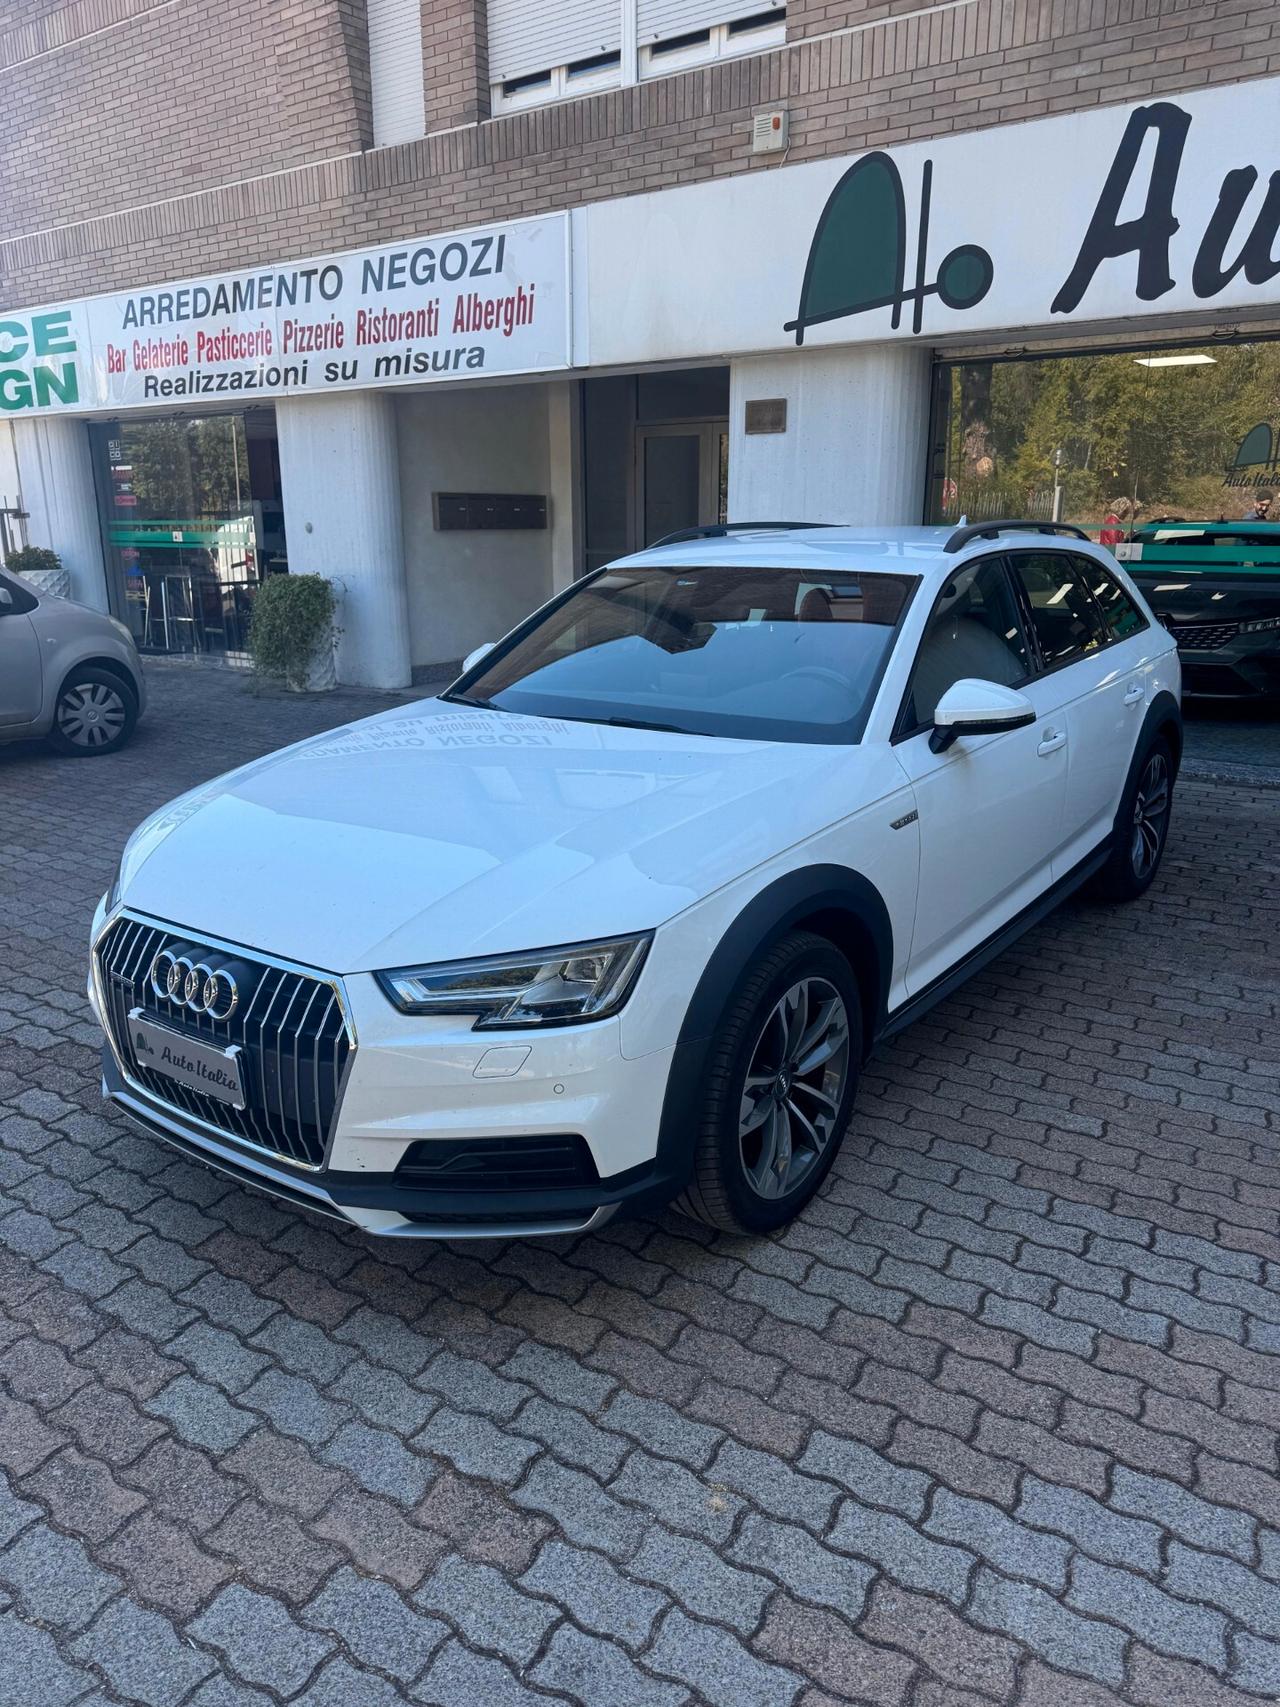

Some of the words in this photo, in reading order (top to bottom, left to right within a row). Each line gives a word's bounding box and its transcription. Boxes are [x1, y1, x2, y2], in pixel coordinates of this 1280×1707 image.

[122, 264, 343, 330] ARREDAMENTO
[361, 234, 506, 295] NEGOZI
[107, 343, 126, 374] Bar
[132, 334, 188, 372] Gelaterie
[196, 321, 272, 364] Pasticcerie
[283, 313, 344, 354] Pizzerie
[356, 298, 440, 346] Ristoranti
[452, 283, 535, 337] Alberghi
[144, 359, 308, 398] Realizzazioni
[324, 359, 358, 383] su
[374, 345, 485, 378] misura
